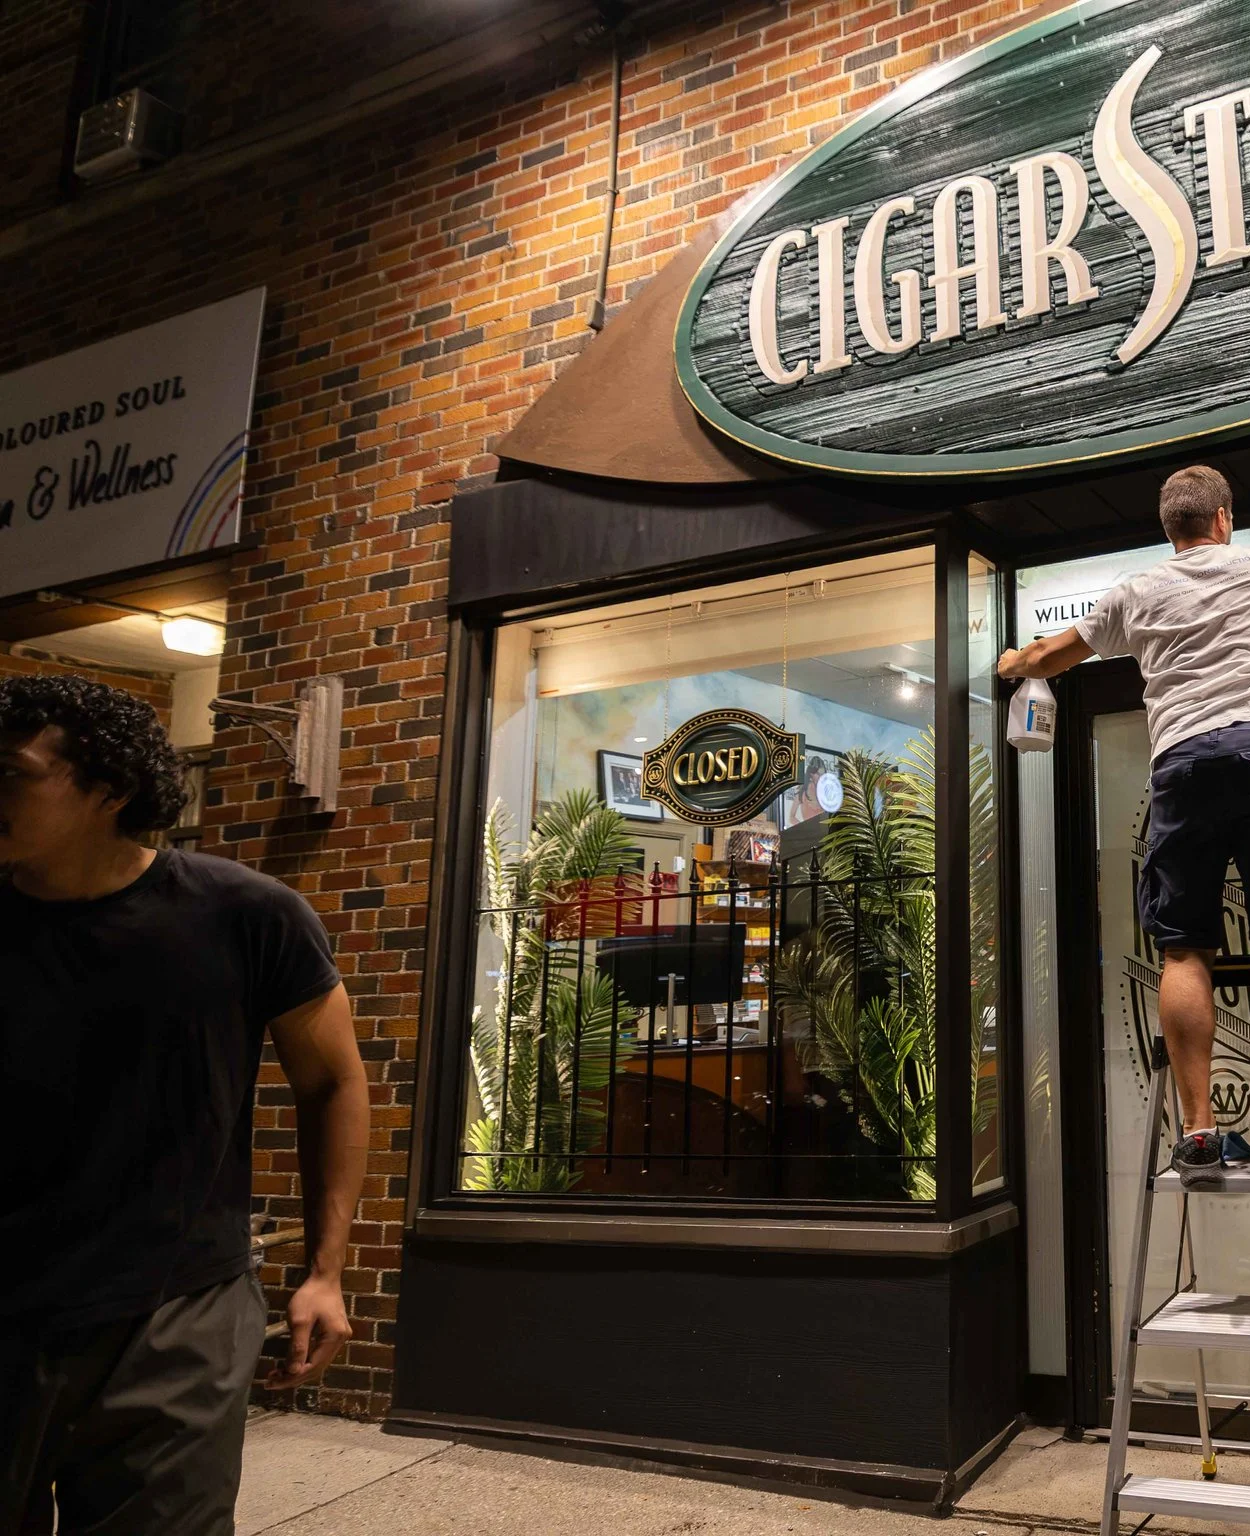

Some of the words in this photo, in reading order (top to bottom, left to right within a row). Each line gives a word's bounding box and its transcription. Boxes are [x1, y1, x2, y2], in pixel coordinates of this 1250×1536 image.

[749, 151, 1099, 386] CIGAR
[0, 400, 105, 452] LOURED
[116, 376, 186, 417] SOUL
[27, 465, 59, 520] &
[68, 440, 178, 511] Wellness
[1035, 599, 1099, 624] WILLIN
[673, 745, 758, 786] CLOSED
